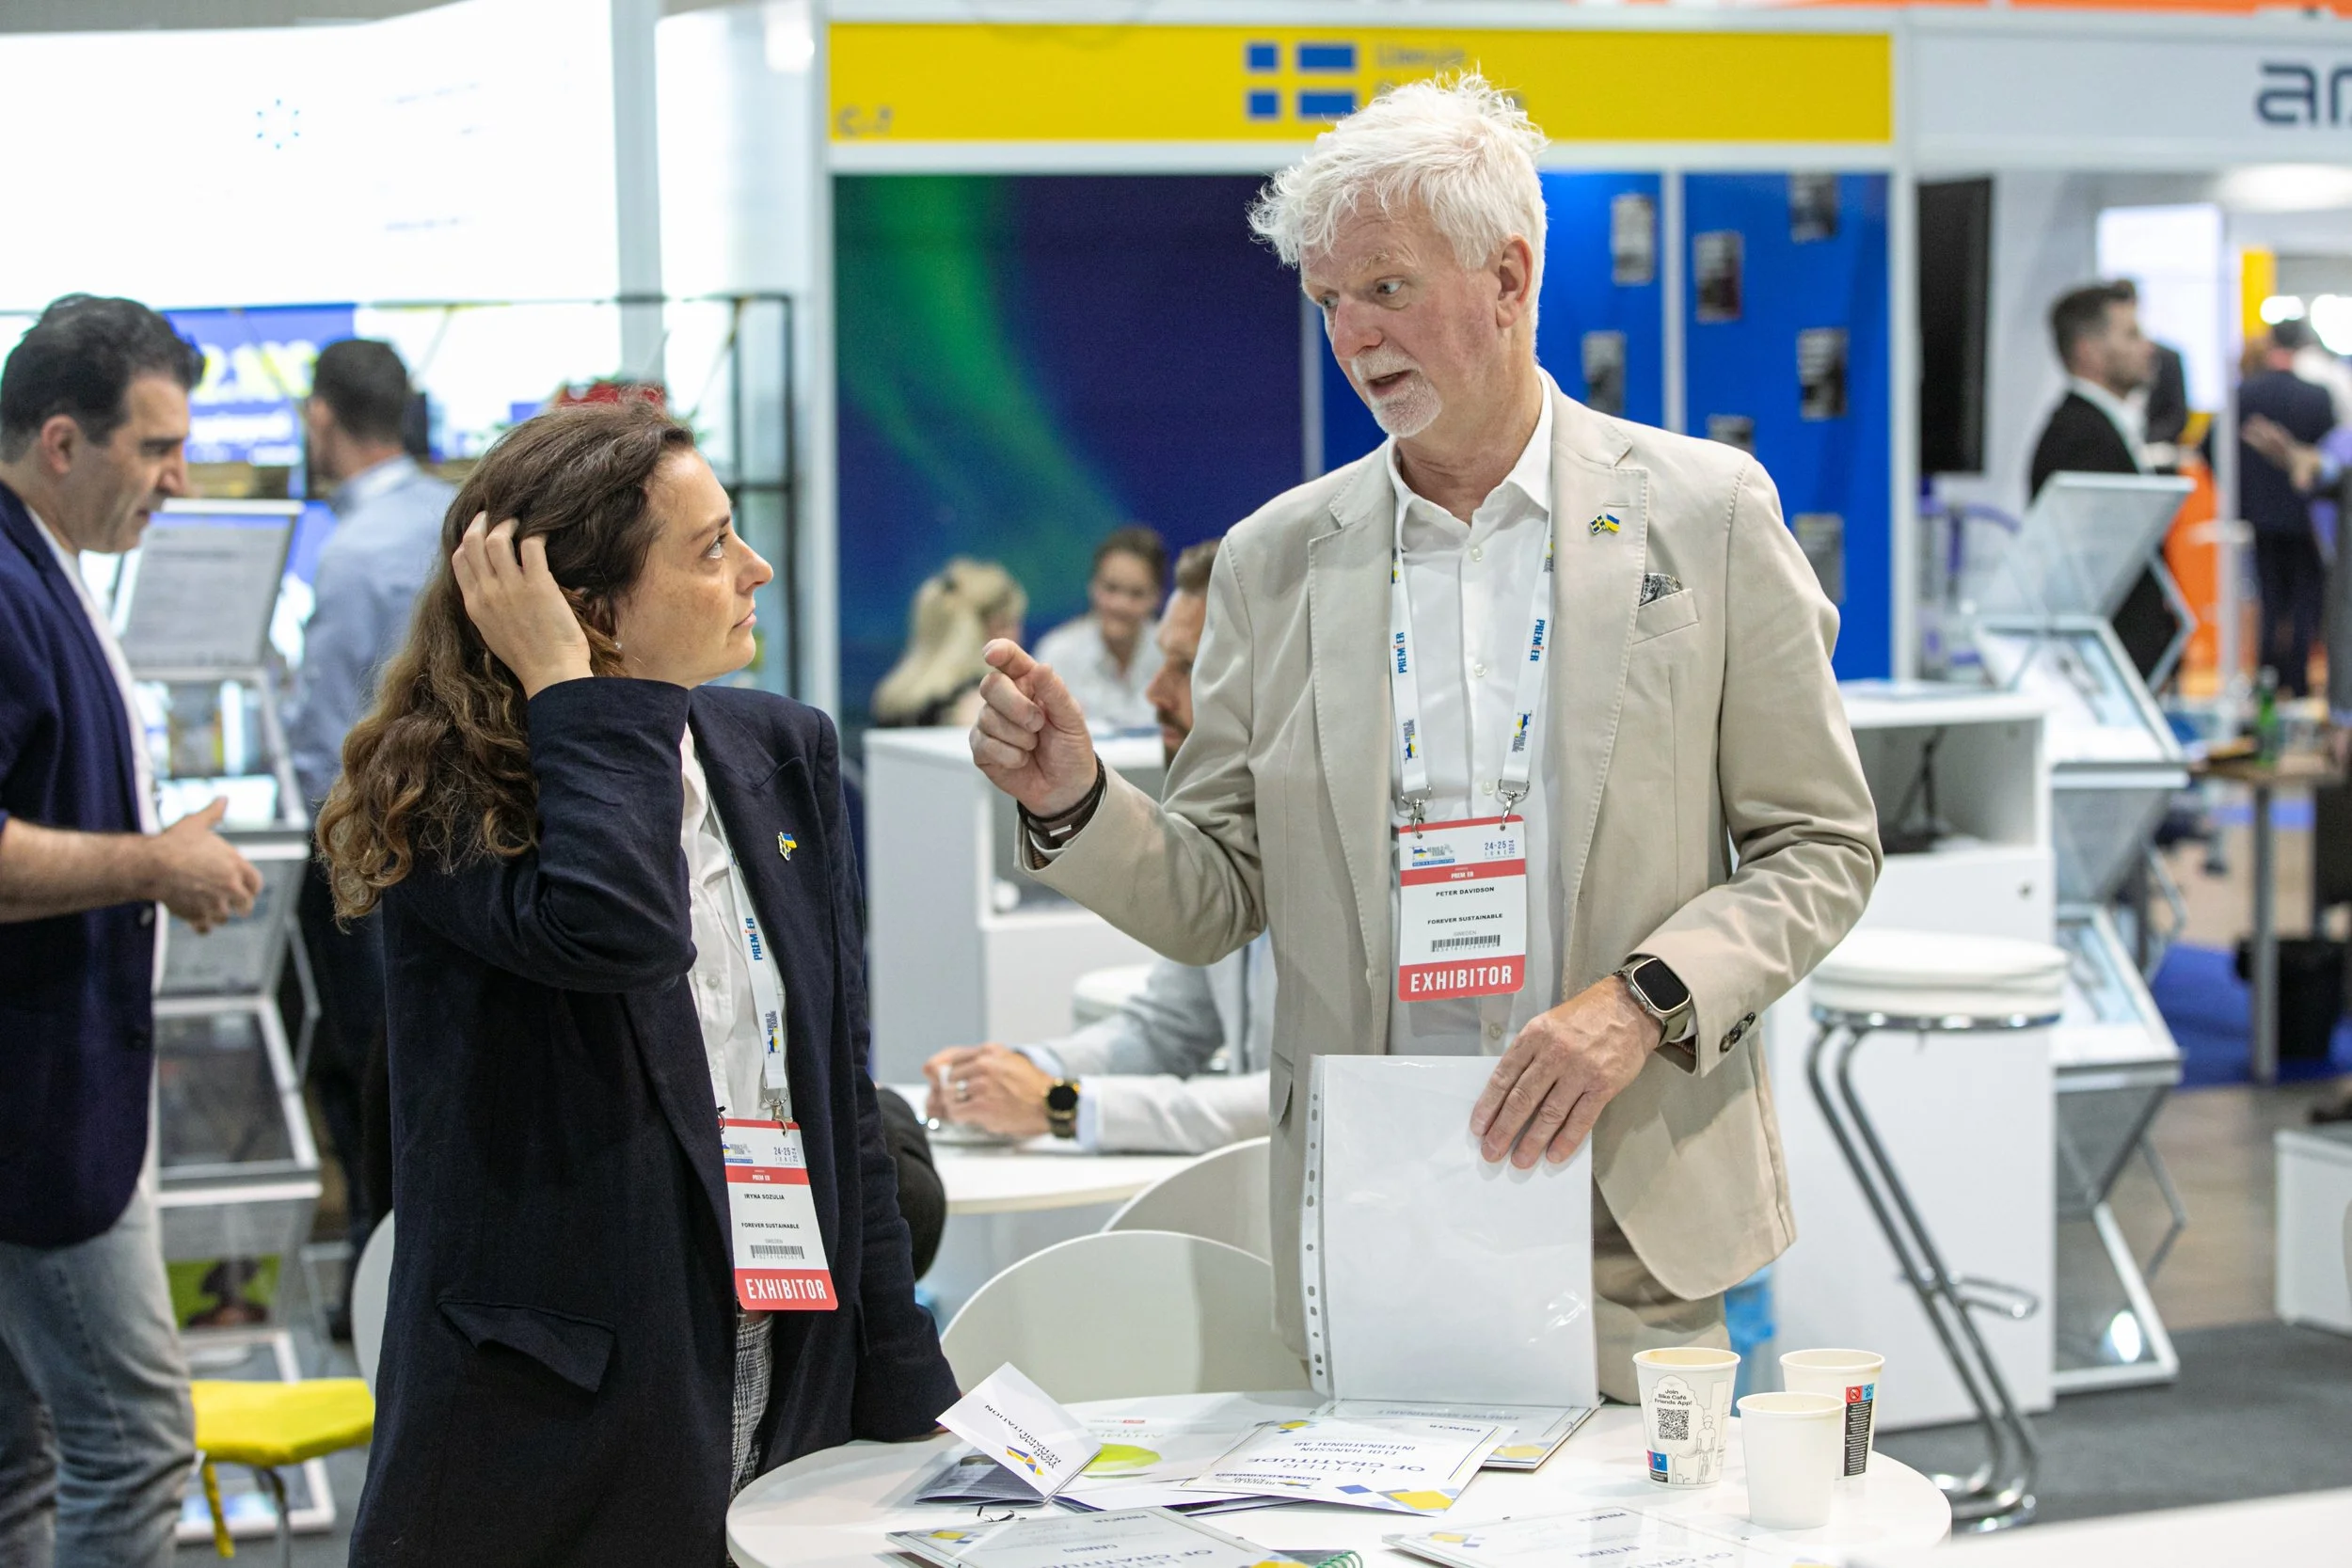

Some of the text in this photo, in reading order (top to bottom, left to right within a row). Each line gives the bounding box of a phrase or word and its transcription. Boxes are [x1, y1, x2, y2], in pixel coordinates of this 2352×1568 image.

[1485, 840, 1506, 851] 24-25
[1436, 886, 1495, 897] PETER DAVIDSON
[1427, 912, 1503, 925] FOREVER SUSTAINABLE
[1411, 965, 1512, 992] EXHIBITOR
[773, 1147, 791, 1156] 24-25
[745, 1278, 827, 1300] EXHIBITOR
[985, 1404, 1061, 1464] REHABILITATION
[1018, 1433, 1057, 1465] TRAUMA
[1317, 1442, 1417, 1451] INTERNATIONAL
[1033, 1450, 1056, 1469] WAR
[1246, 1457, 1386, 1469] GRATITUDE
[1282, 1464, 1377, 1474] LETTER
